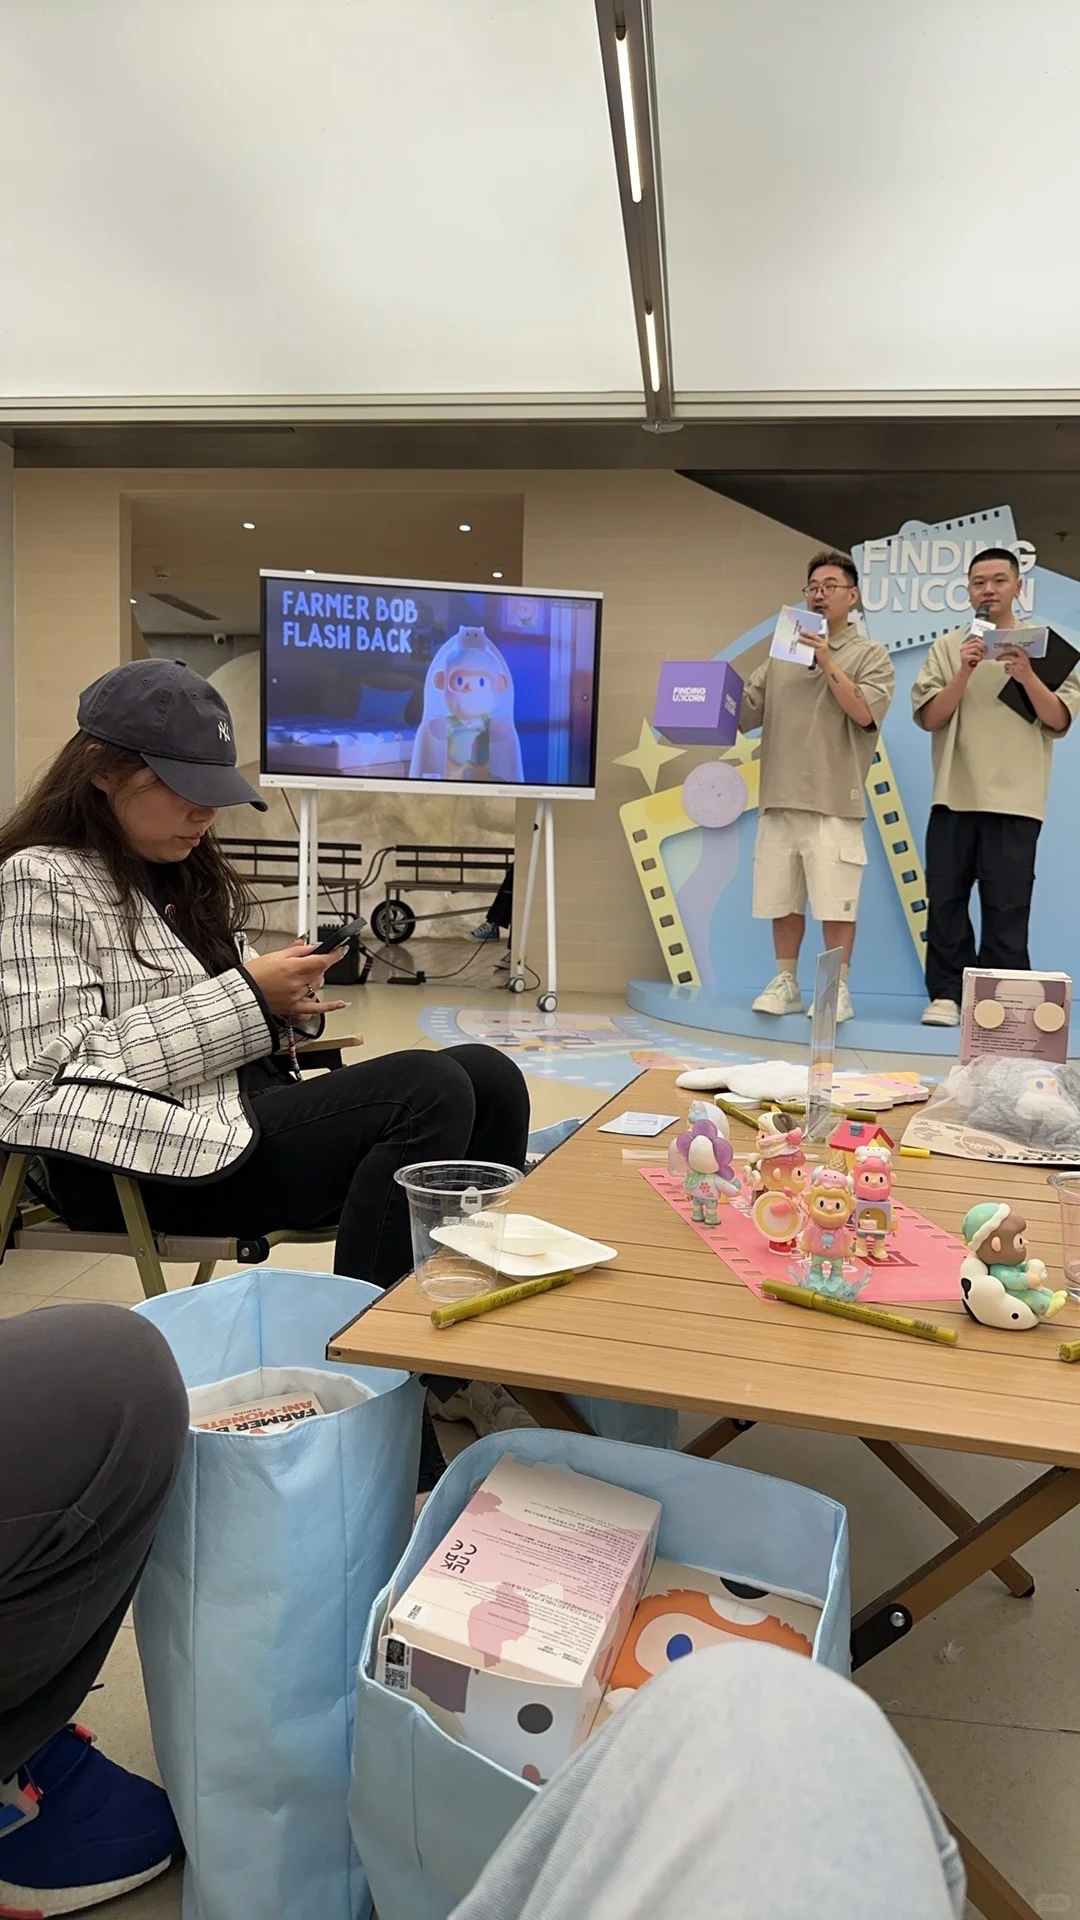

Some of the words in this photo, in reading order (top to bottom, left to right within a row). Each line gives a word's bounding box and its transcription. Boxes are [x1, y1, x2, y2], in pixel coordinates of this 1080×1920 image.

[862, 540, 1037, 575] FINDIG
[861, 577, 1035, 612] UNICON
[282, 590, 370, 621] FARMER
[376, 597, 418, 624] BOB
[282, 621, 351, 650] FLASH
[356, 626, 413, 654] BACK
[672, 694, 705, 702] UNICORN
[673, 686, 706, 695] FINDING
[218, 721, 231, 742] NY
[199, 1401, 312, 1430] ANI-MONSTE
[235, 1408, 316, 1432] FARMER
[444, 1550, 470, 1566] CA
[451, 1539, 477, 1556] CE
[439, 1558, 465, 1574] UK
